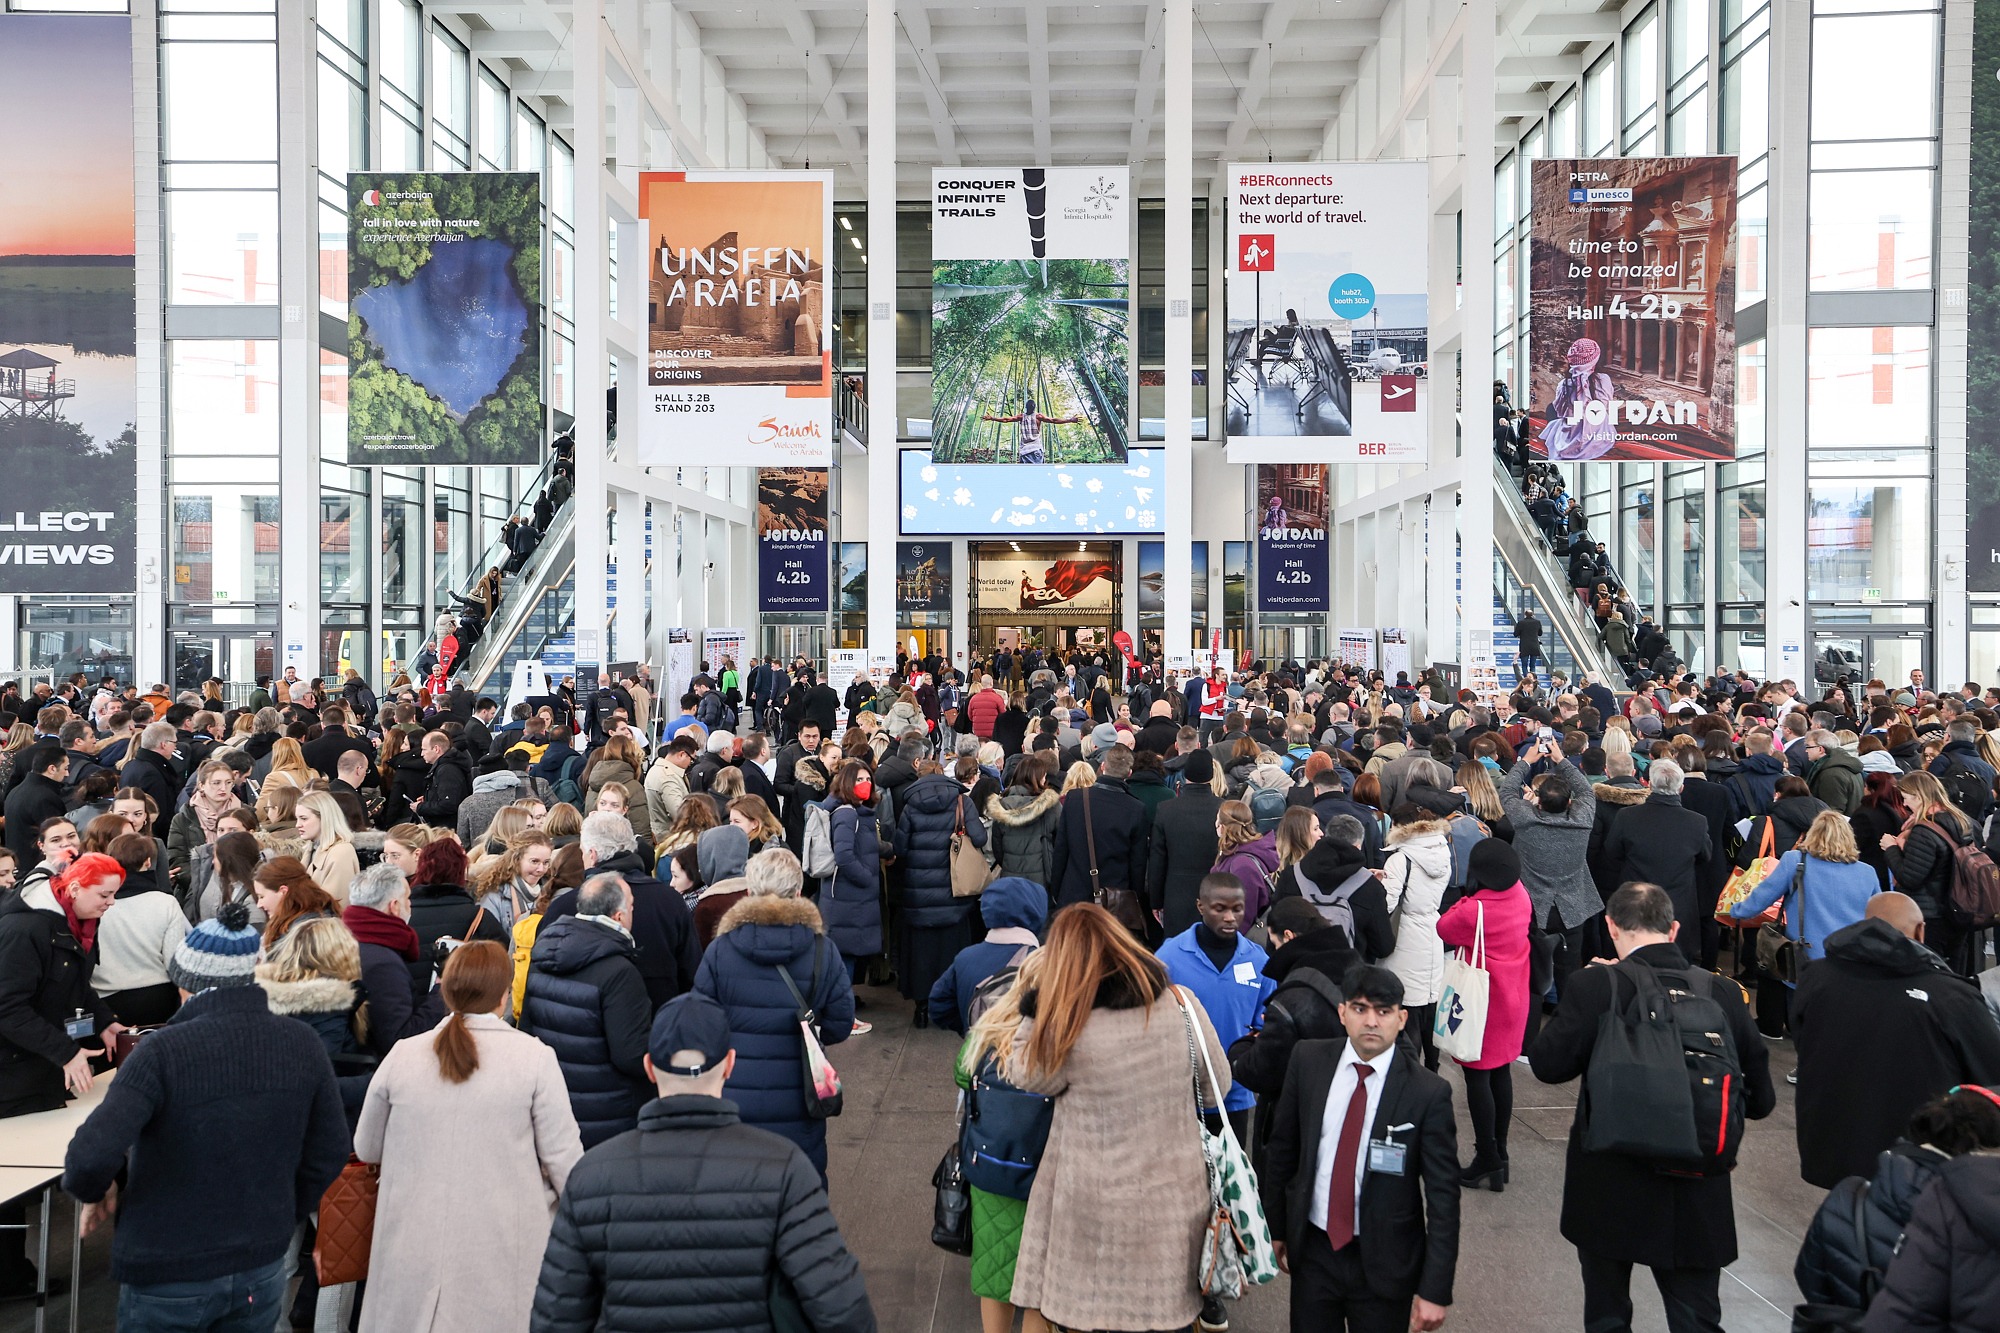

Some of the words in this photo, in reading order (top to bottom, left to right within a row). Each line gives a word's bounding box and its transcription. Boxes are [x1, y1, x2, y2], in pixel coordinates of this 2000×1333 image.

[1239, 174, 1333, 187] #BERconnects
[1570, 172, 1609, 182] PETRA
[937, 180, 1016, 191] CONQUER
[386, 190, 433, 200] azerbaijan
[937, 194, 1006, 204] INFINITE
[1591, 190, 1630, 199] unesco
[1239, 193, 1270, 205] Next
[1274, 193, 1344, 208] departure:
[938, 208, 996, 218] TRAILS
[1590, 206, 1618, 214] Heritage
[1239, 212, 1260, 224] the
[1264, 211, 1302, 224] world
[1307, 210, 1321, 223] of
[1325, 210, 1366, 223] travel.
[363, 218, 380, 227] fall
[382, 218, 392, 227] in
[395, 218, 417, 227] love
[420, 218, 442, 227] with
[444, 219, 480, 227] nature
[363, 233, 412, 244] experience
[414, 232, 464, 244] Azerbaijan
[1568, 238, 1612, 254] time
[1617, 238, 1638, 254] to
[1568, 262, 1592, 278] be
[1598, 261, 1678, 278] amazed
[1567, 305, 1603, 320] Hall
[1608, 294, 1682, 320] 4.2b
[654, 350, 712, 359] DISCOVER
[654, 360, 679, 369] OUR
[654, 370, 702, 380] ORIGINS
[655, 394, 684, 402] HALL
[687, 394, 710, 402] 3.2B
[654, 404, 692, 413] STAND
[696, 404, 716, 413] 203
[1586, 432, 1678, 442] visitjordan.com
[1358, 443, 1386, 455] BER
[1271, 542, 1295, 550] kingdom
[1296, 542, 1302, 550] of
[784, 560, 802, 568] Hall
[1284, 560, 1303, 568] Hall
[776, 572, 811, 584] 4.2b
[996, 578, 1015, 586] today
[1276, 571, 1312, 584] 4.2b
[767, 596, 820, 604] visitjordan.com
[1266, 596, 1320, 604] visitjordan.com
